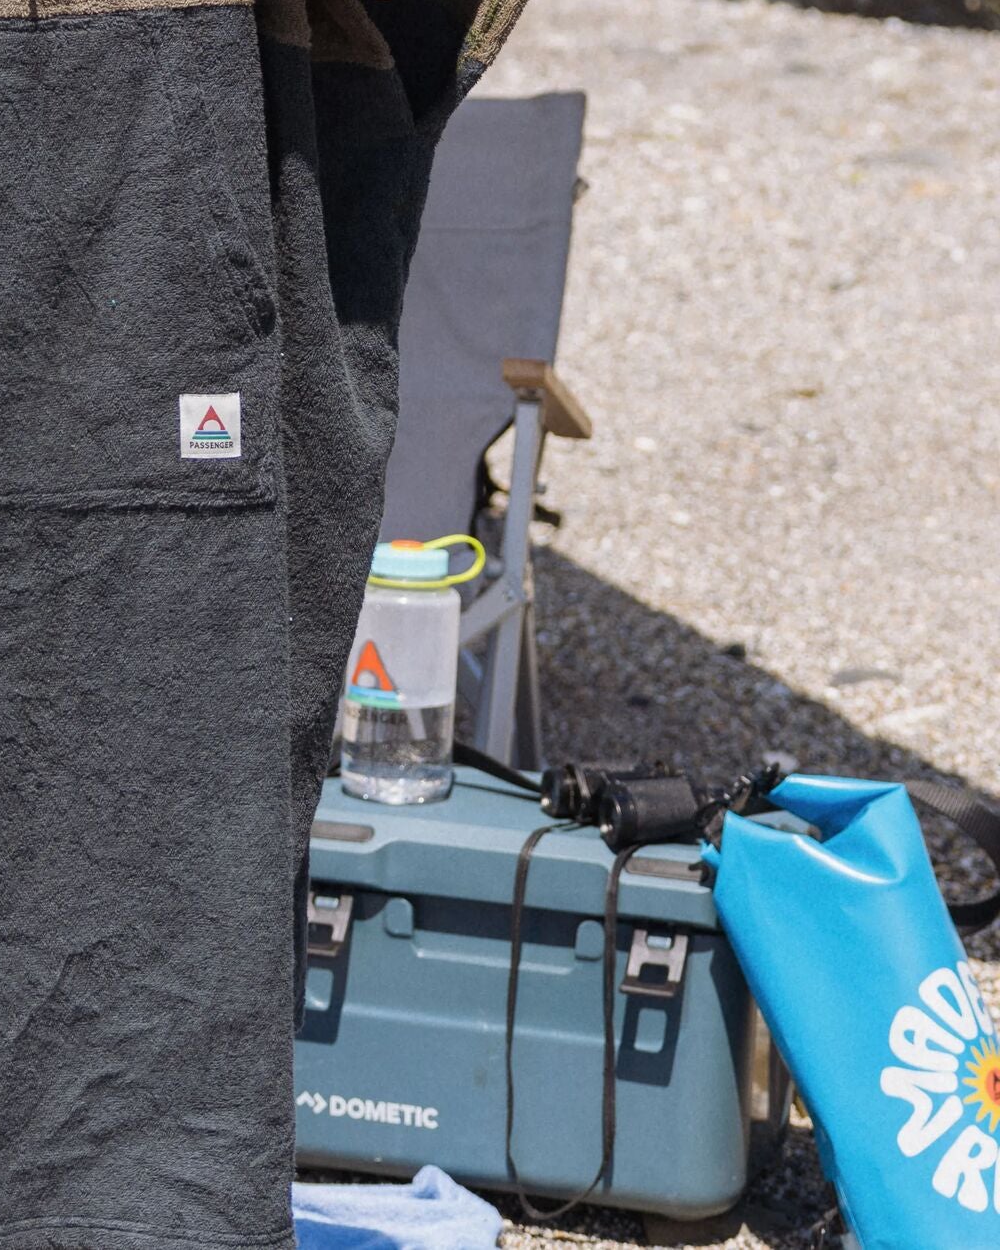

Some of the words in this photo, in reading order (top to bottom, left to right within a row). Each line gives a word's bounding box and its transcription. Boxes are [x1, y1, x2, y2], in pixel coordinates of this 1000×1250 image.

[189, 441, 234, 449] PASSENGER
[329, 1095, 438, 1129] DOMETIC
[932, 1125, 1000, 1215] R
